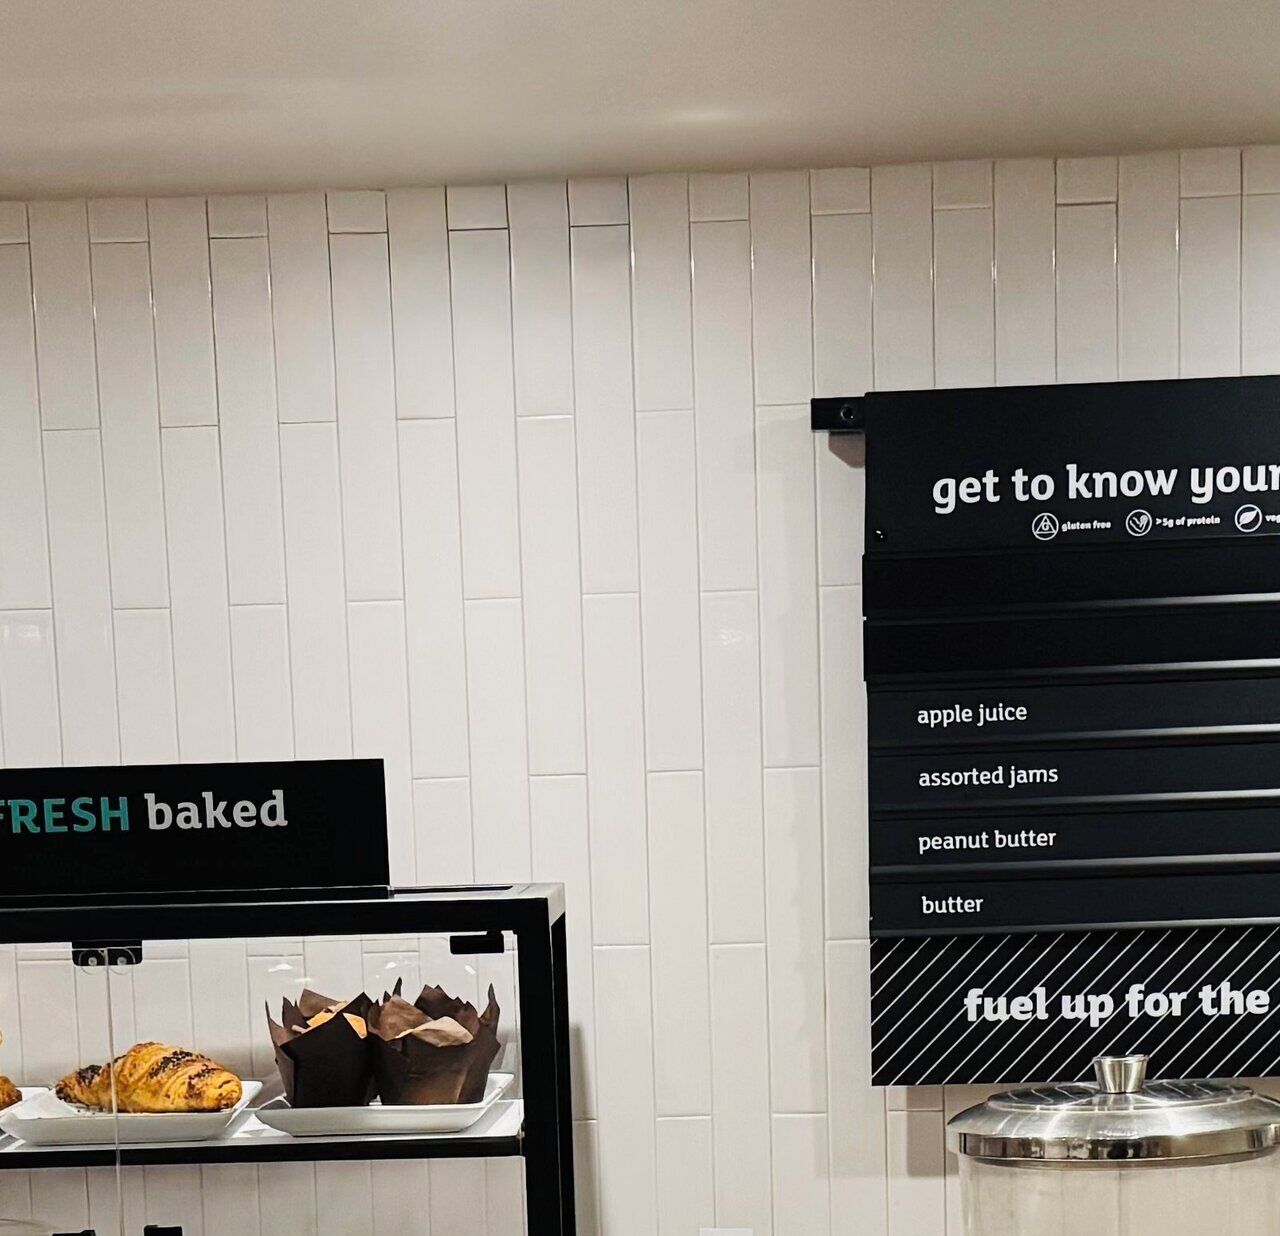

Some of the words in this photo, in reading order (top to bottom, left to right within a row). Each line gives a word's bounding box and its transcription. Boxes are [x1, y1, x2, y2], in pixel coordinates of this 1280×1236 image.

[933, 470, 1000, 514] get
[1012, 469, 1054, 501] to
[1066, 464, 1178, 499] know
[1062, 521, 1091, 532] gluten
[1093, 520, 1111, 529] free
[1187, 515, 1220, 527] protein
[918, 705, 972, 728] apple
[977, 703, 1027, 726] juice
[919, 766, 1003, 786] assorted
[1008, 766, 1058, 788] jams
[144, 790, 287, 829] baked
[919, 832, 989, 854] peanut
[994, 830, 1056, 847] butter
[922, 896, 983, 913] butter
[964, 987, 1049, 1022] fuel
[1061, 993, 1115, 1028] up
[1125, 984, 1187, 1018] for
[1198, 981, 1271, 1016] the
